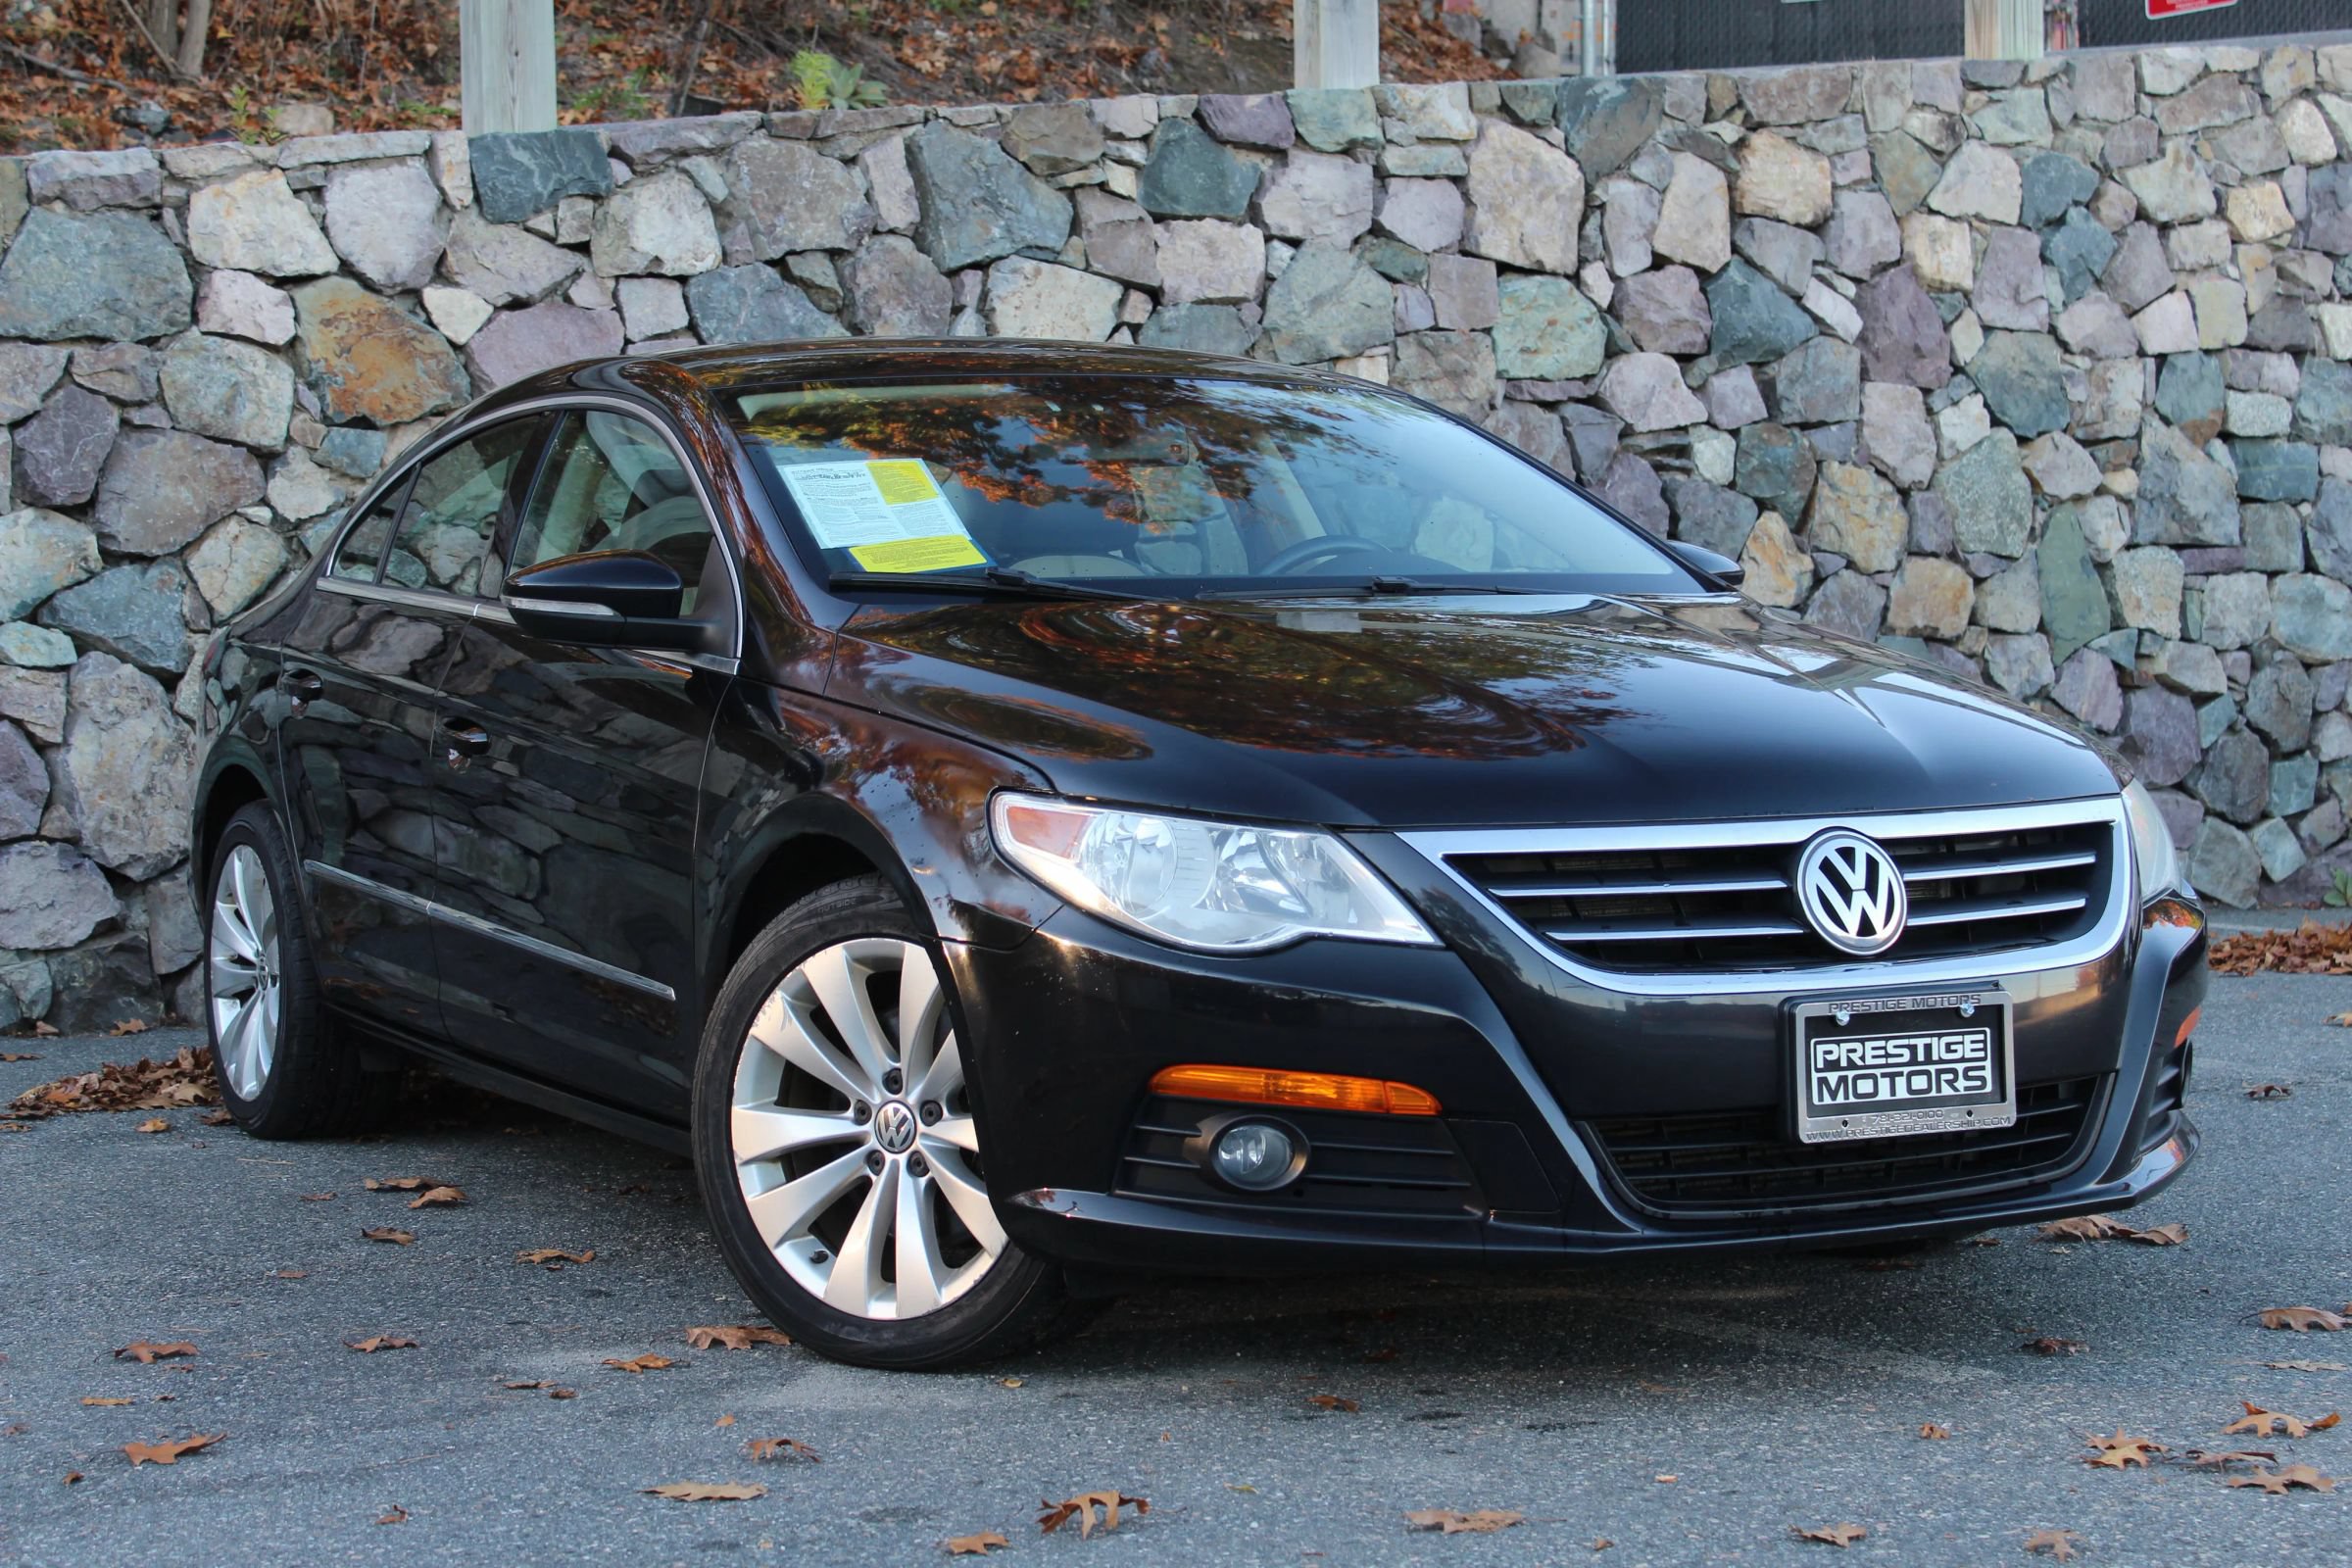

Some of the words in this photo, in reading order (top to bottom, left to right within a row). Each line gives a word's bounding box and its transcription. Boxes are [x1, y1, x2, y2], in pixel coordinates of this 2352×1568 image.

[1829, 999, 1907, 1013] PRESTIGE
[1912, 994, 1982, 1008] MOTORS
[1816, 1033, 1985, 1069] PRESTIGE
[1817, 1065, 1987, 1103] MOTORS
[1806, 1115, 2011, 1142] WWW.PRESTIGEDEALERSHIP.COM
[1872, 1109, 1944, 1125] 781-321-0100
